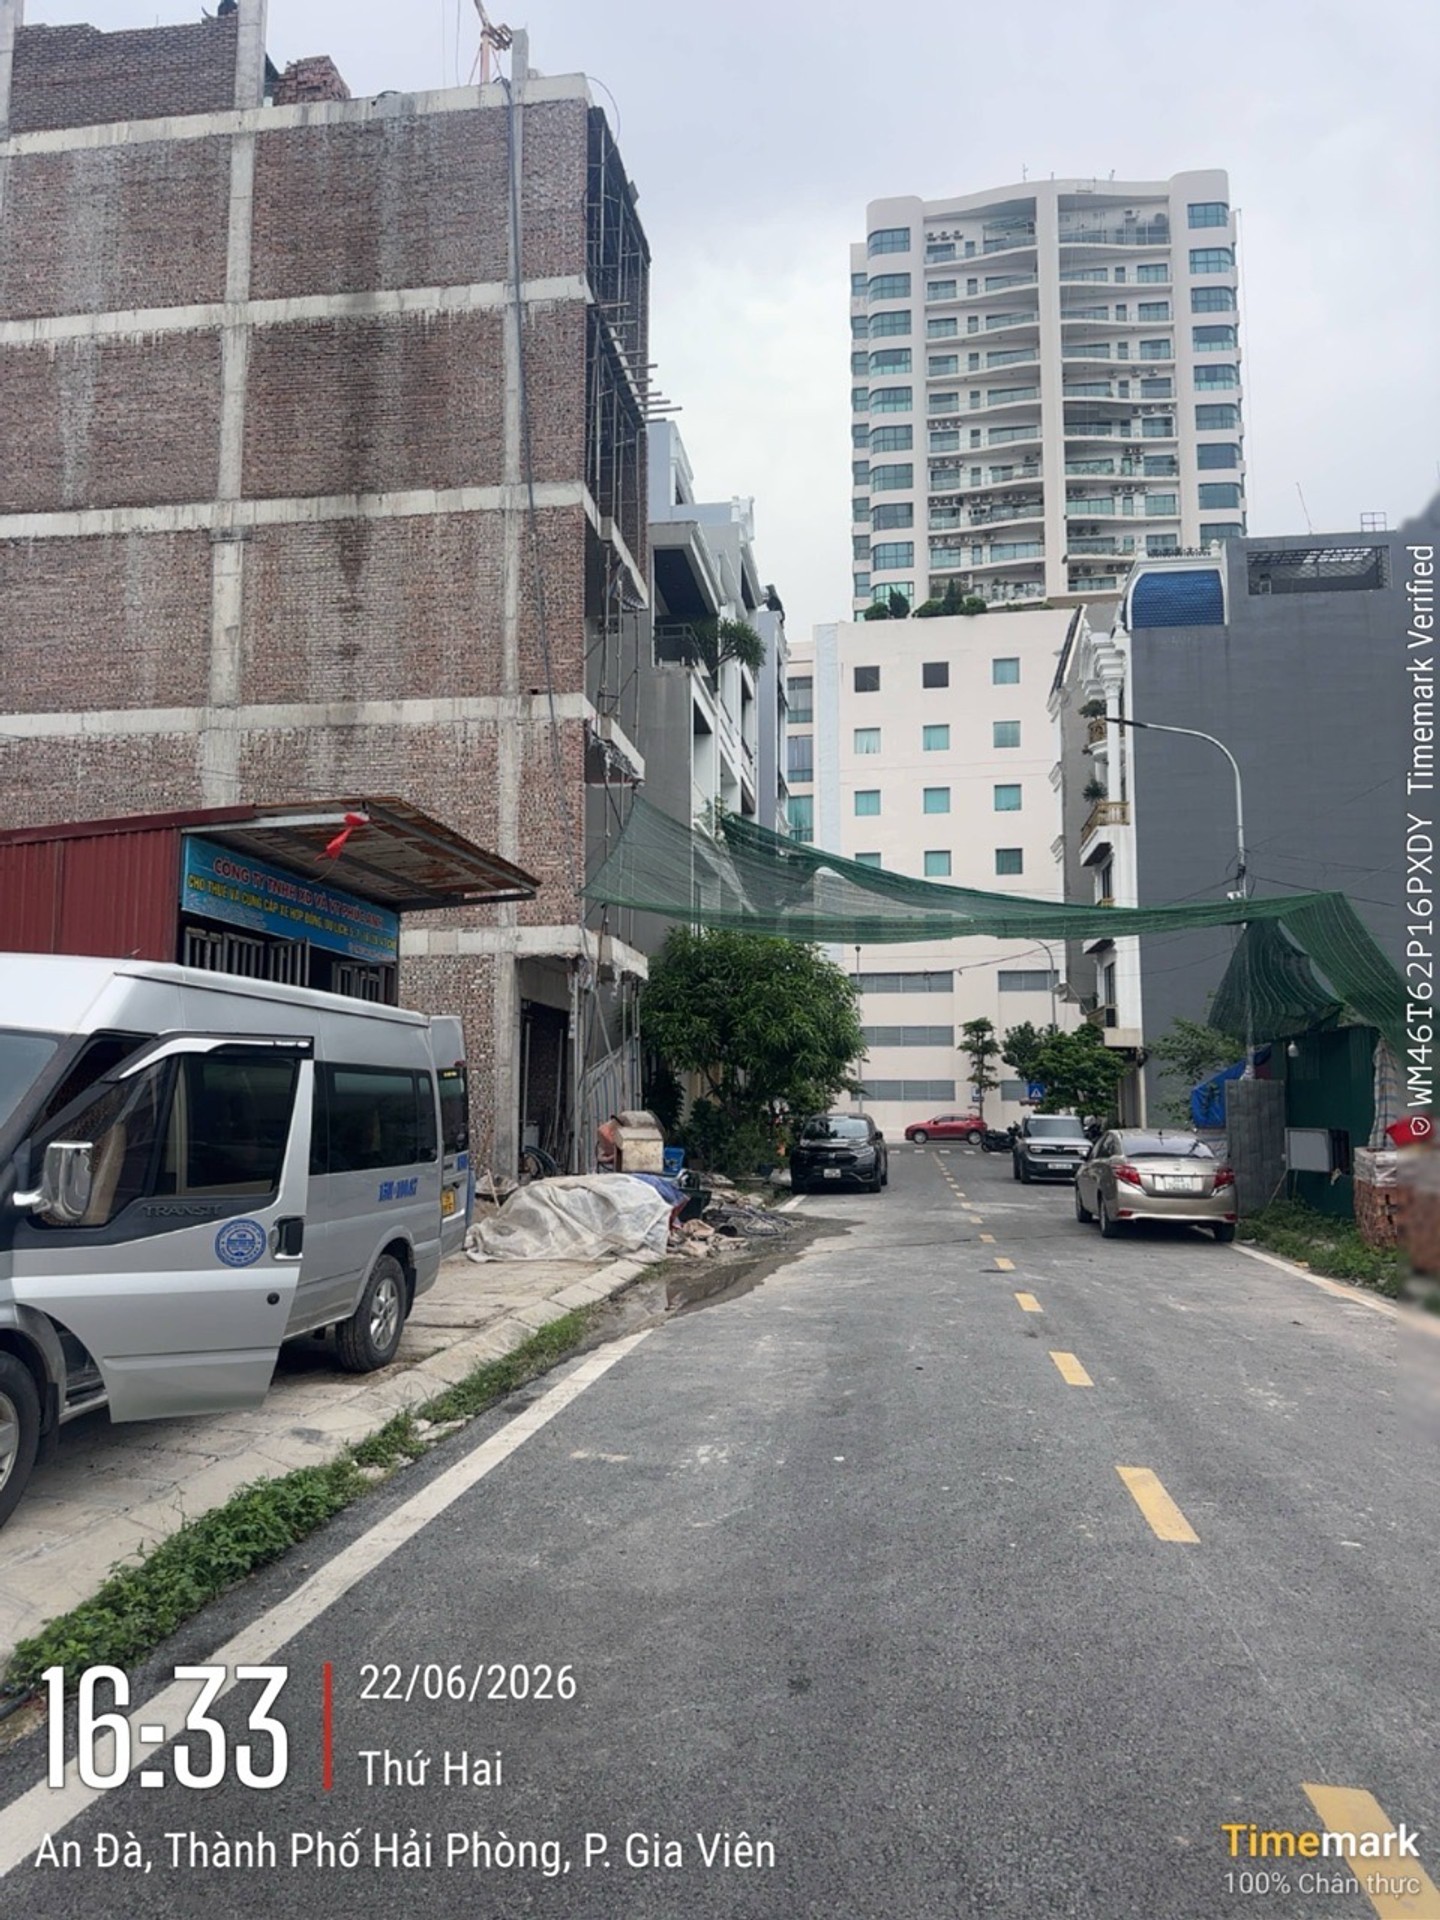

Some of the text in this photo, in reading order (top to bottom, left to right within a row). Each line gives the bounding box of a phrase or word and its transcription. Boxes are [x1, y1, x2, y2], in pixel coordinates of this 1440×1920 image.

[188, 874, 205, 891] CHO
[213, 856, 251, 885] CÔNG
[252, 872, 266, 889] TY
[266, 876, 296, 900] TNHH
[144, 1204, 222, 1217] TRANSIT
